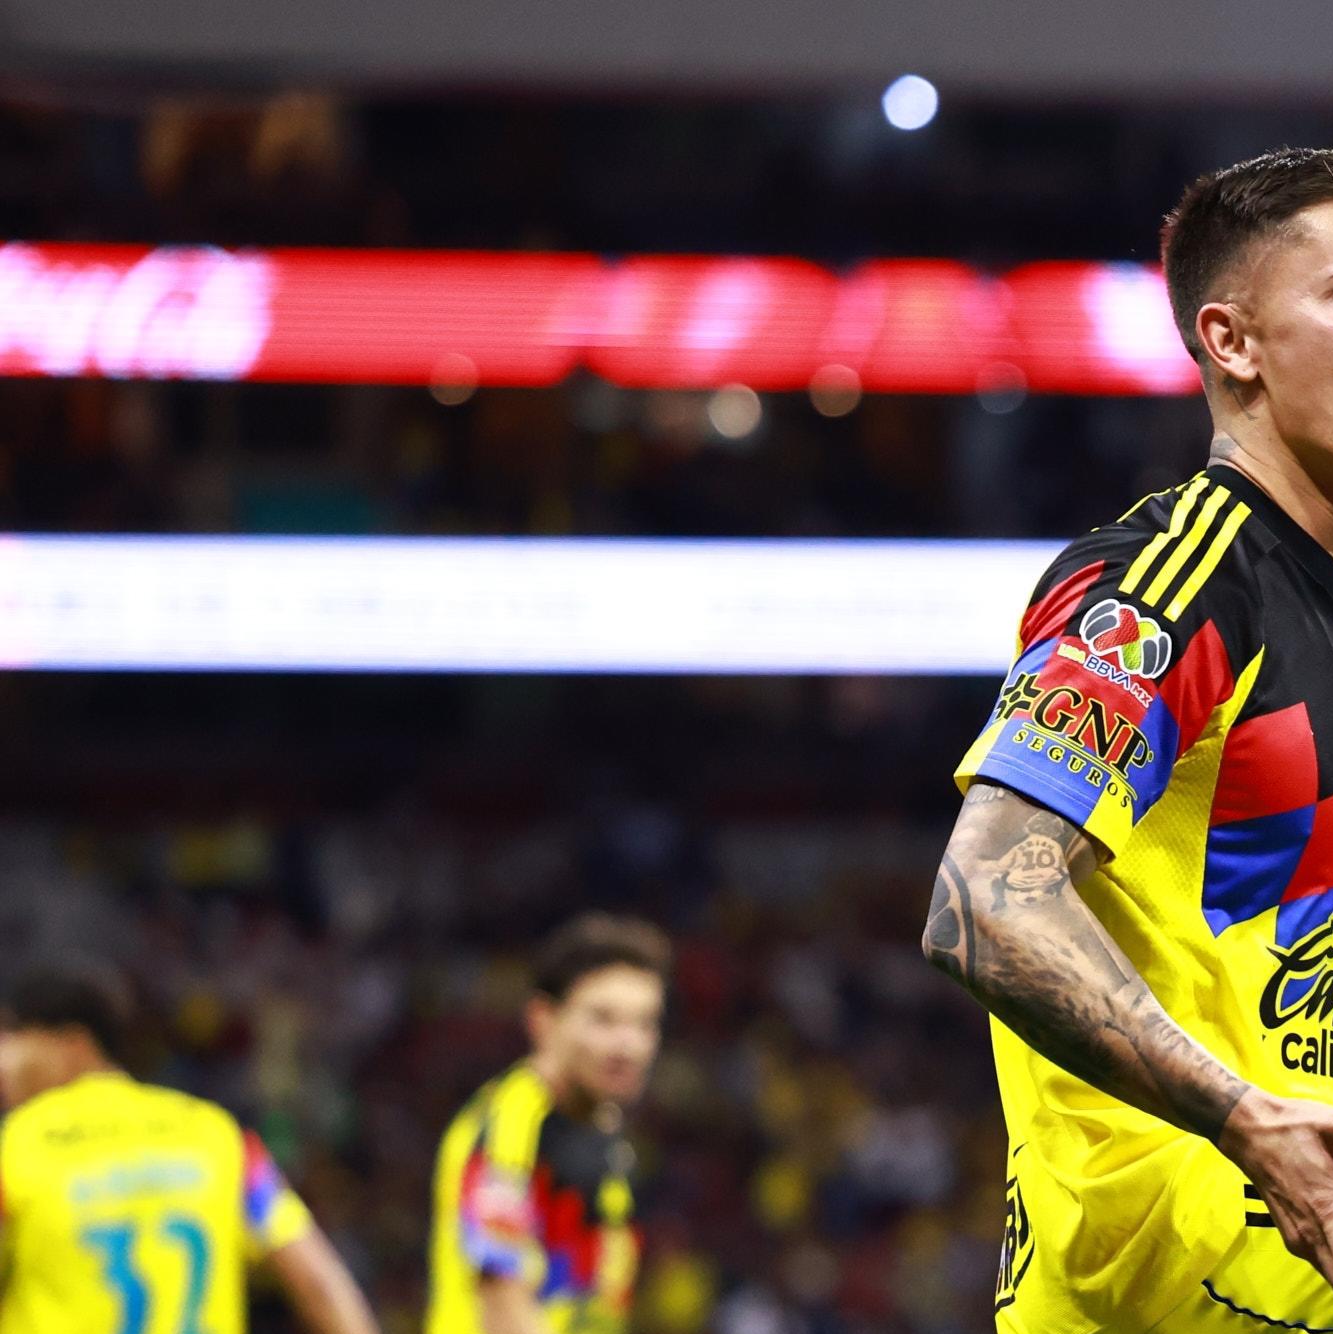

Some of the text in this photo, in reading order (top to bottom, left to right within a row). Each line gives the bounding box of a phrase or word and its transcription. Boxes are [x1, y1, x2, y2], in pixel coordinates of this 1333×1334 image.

[1086, 656, 1130, 690] BBVA
[1034, 687, 1150, 779] GNP
[1013, 730, 1131, 808] SEGUROS
[1021, 849, 1055, 871] 10
